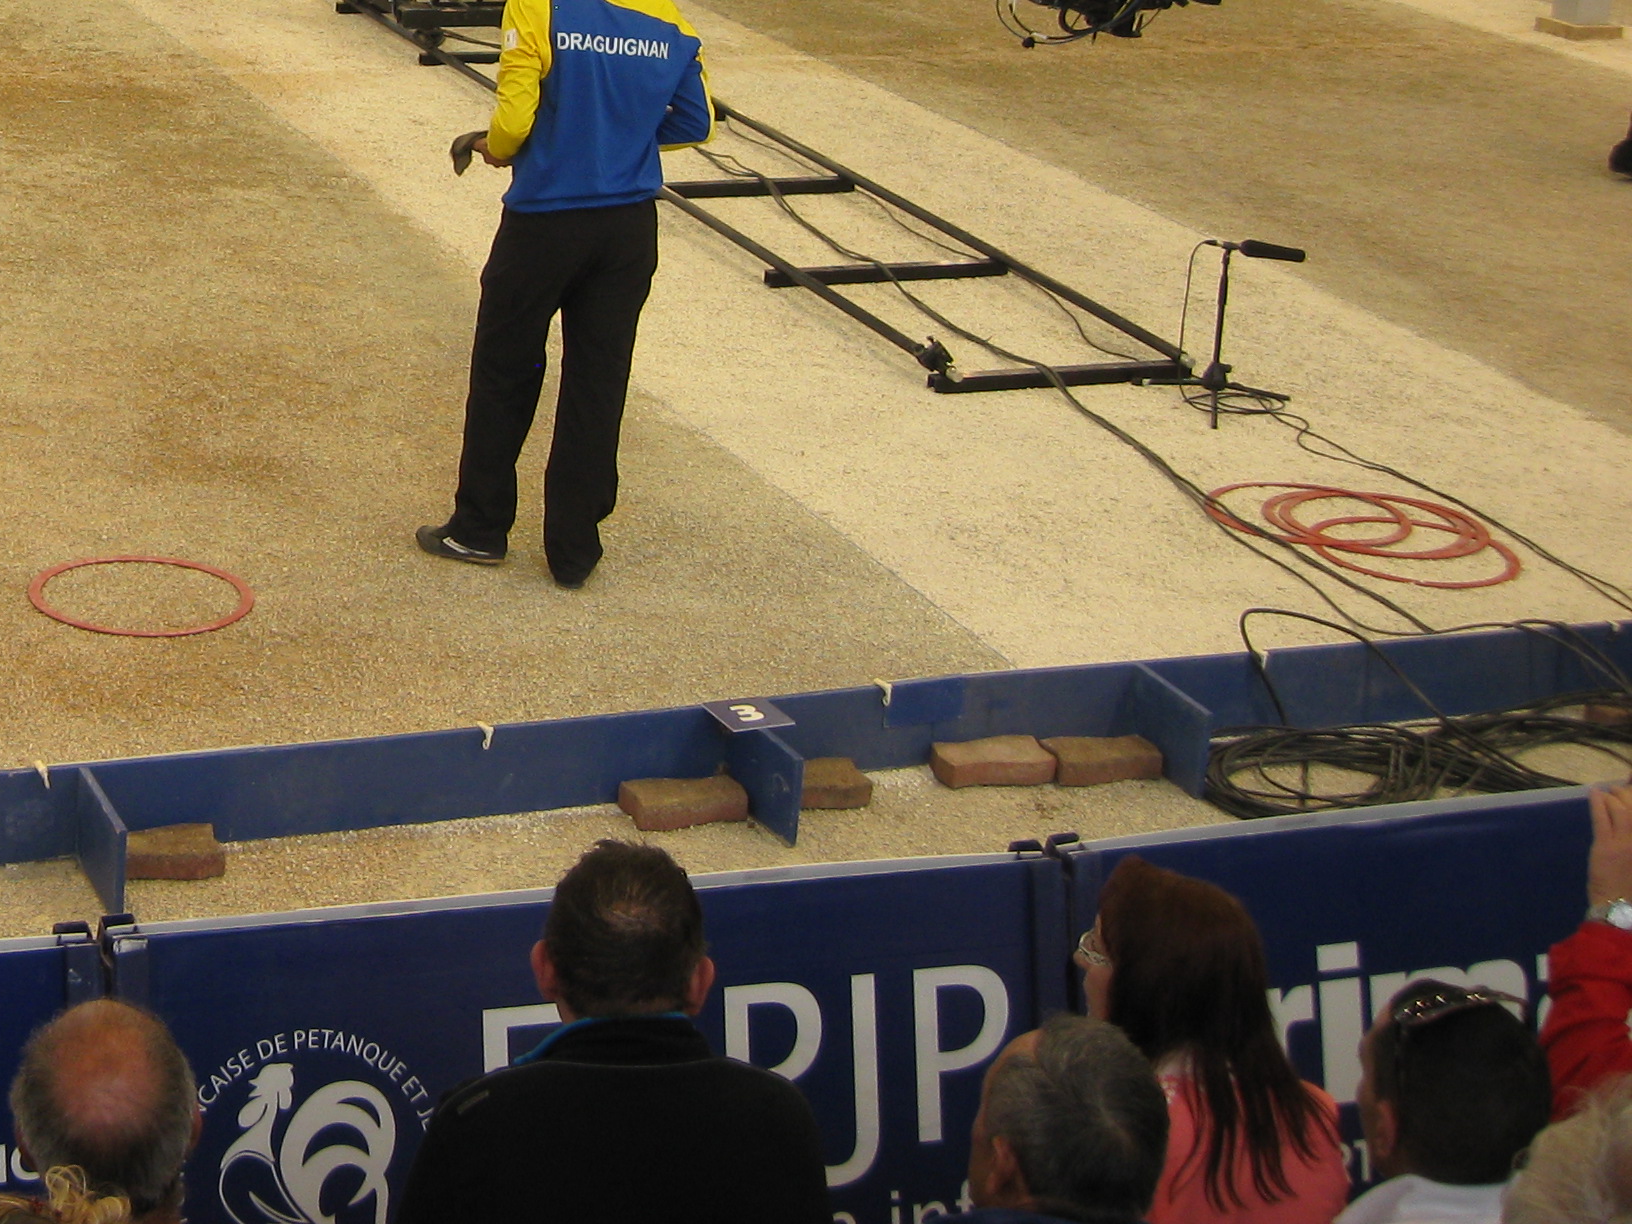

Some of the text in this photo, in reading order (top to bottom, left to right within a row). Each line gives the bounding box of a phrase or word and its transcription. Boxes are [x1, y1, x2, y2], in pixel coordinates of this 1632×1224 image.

[556, 31, 669, 60] DRAGUIGNAN
[729, 704, 766, 722] 3
[257, 1033, 288, 1061] DE
[293, 1029, 408, 1082] PETANQUE
[401, 1075, 428, 1103] ET
